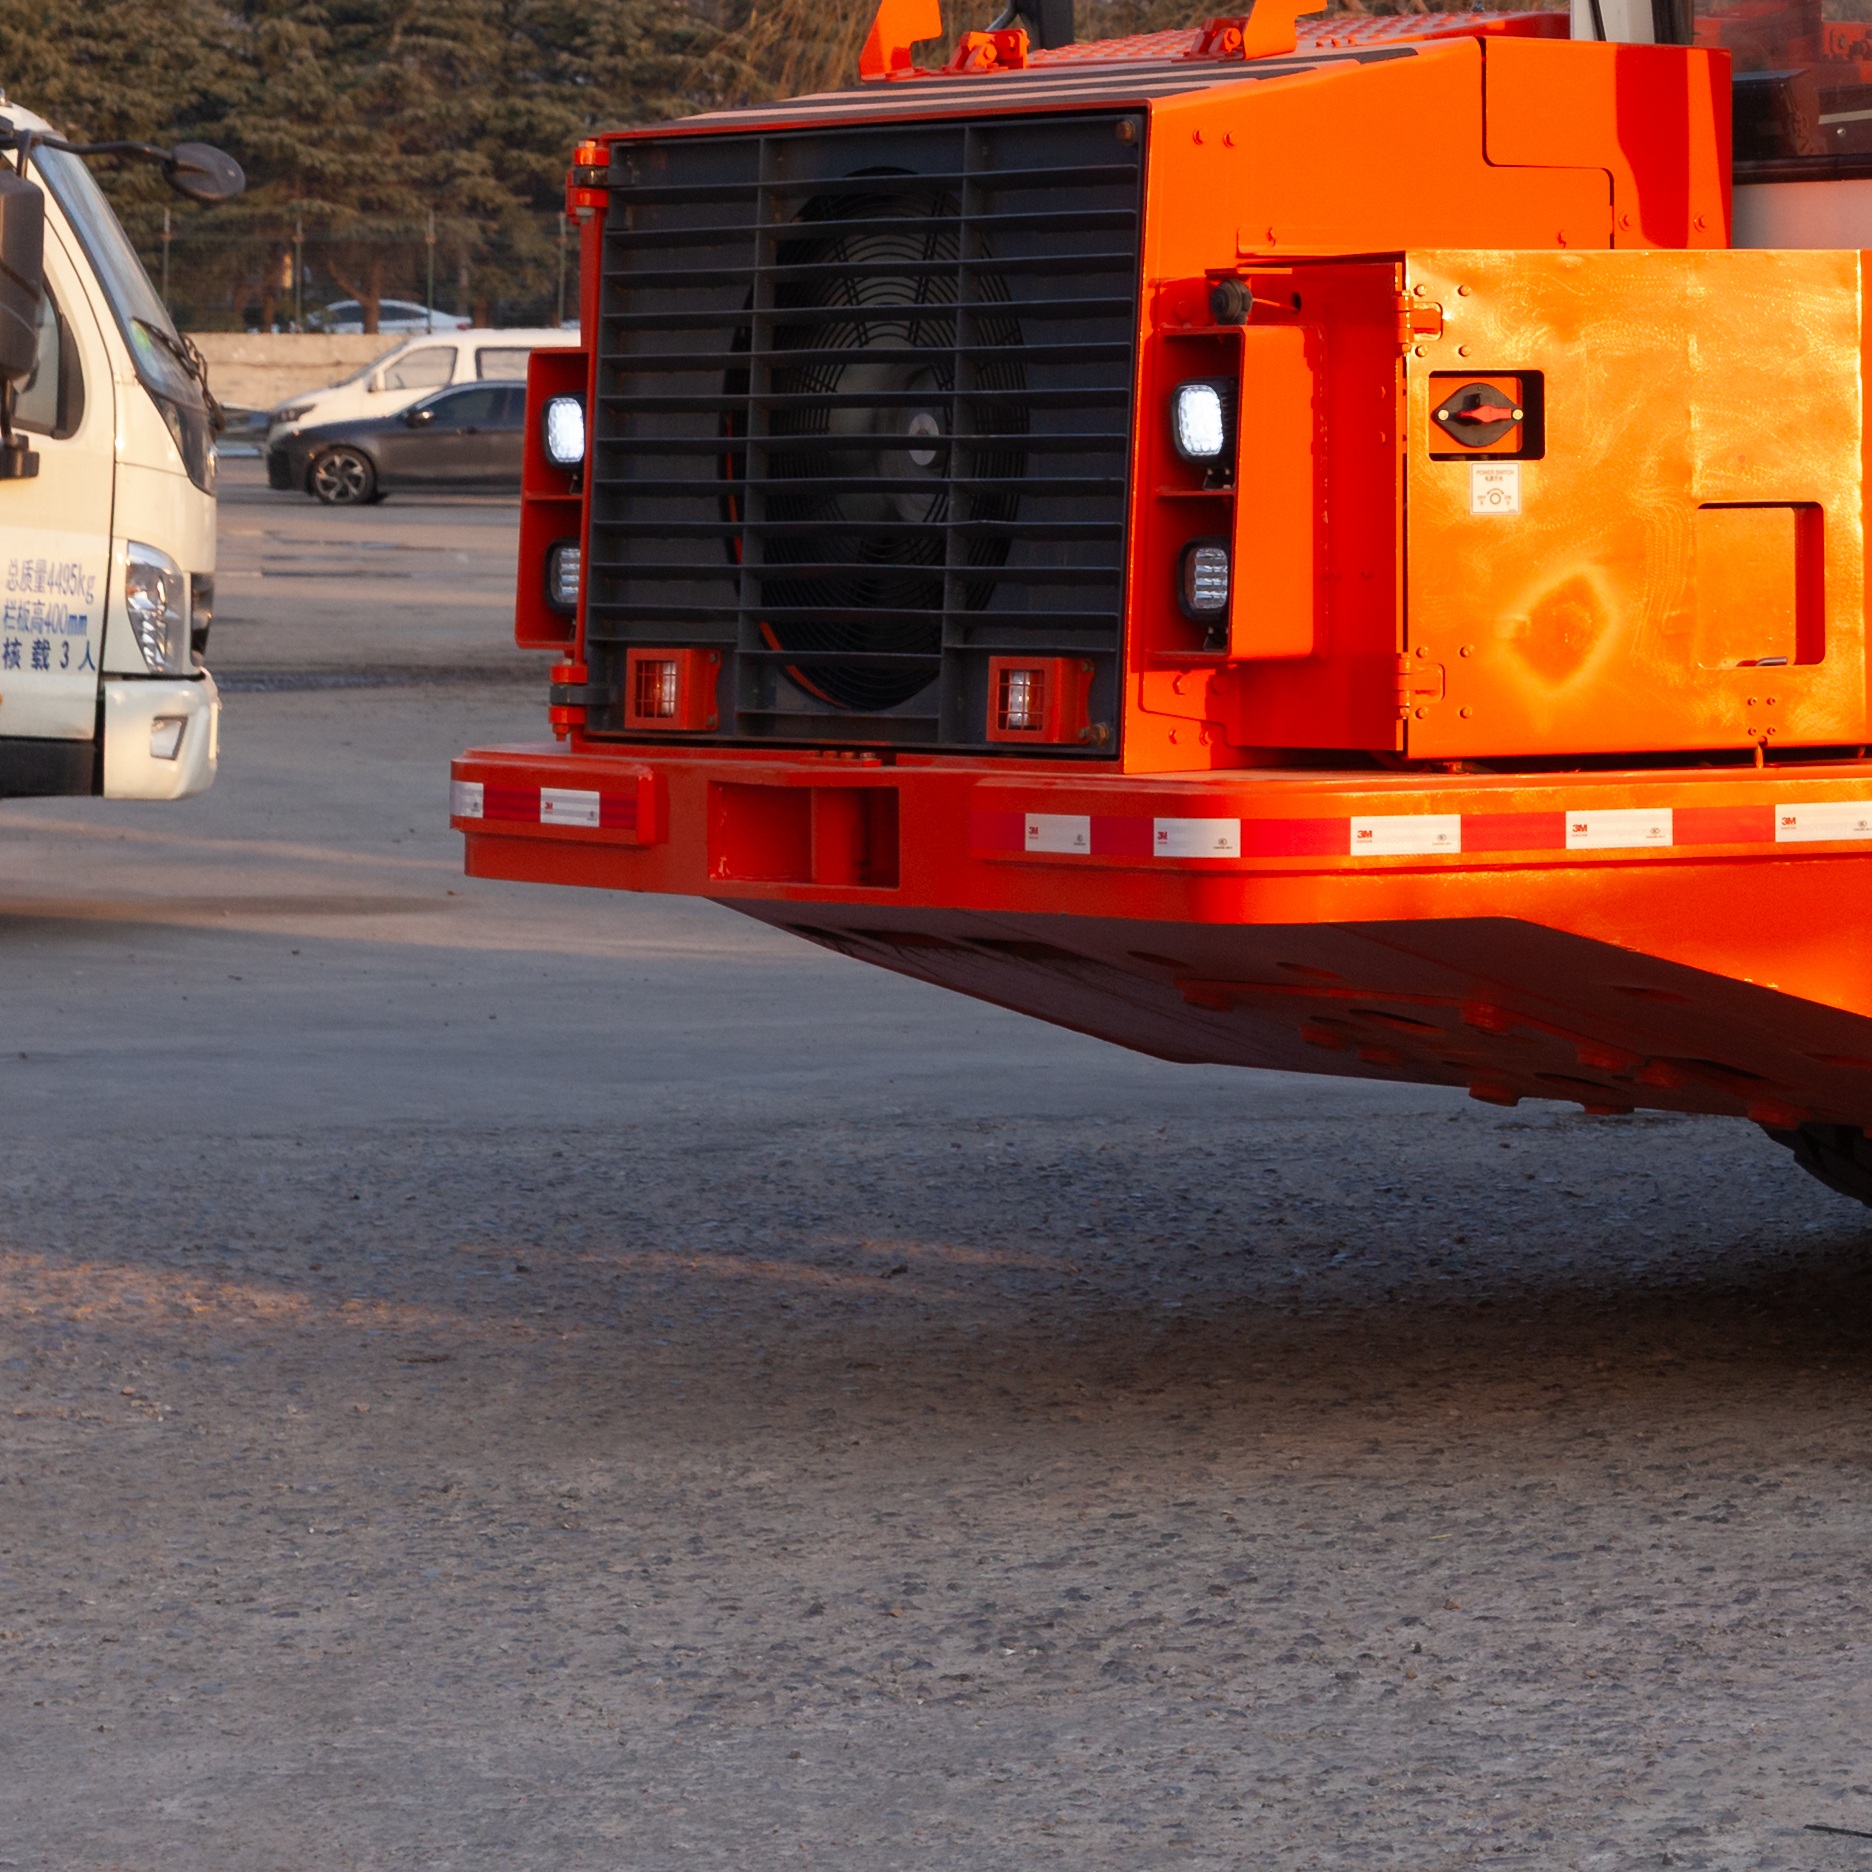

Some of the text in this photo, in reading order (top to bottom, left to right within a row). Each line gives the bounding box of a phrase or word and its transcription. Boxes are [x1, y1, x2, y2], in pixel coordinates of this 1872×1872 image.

[1781, 817, 1796, 826] 3M
[1572, 823, 1588, 832] 3M
[1357, 830, 1373, 839] 3M
